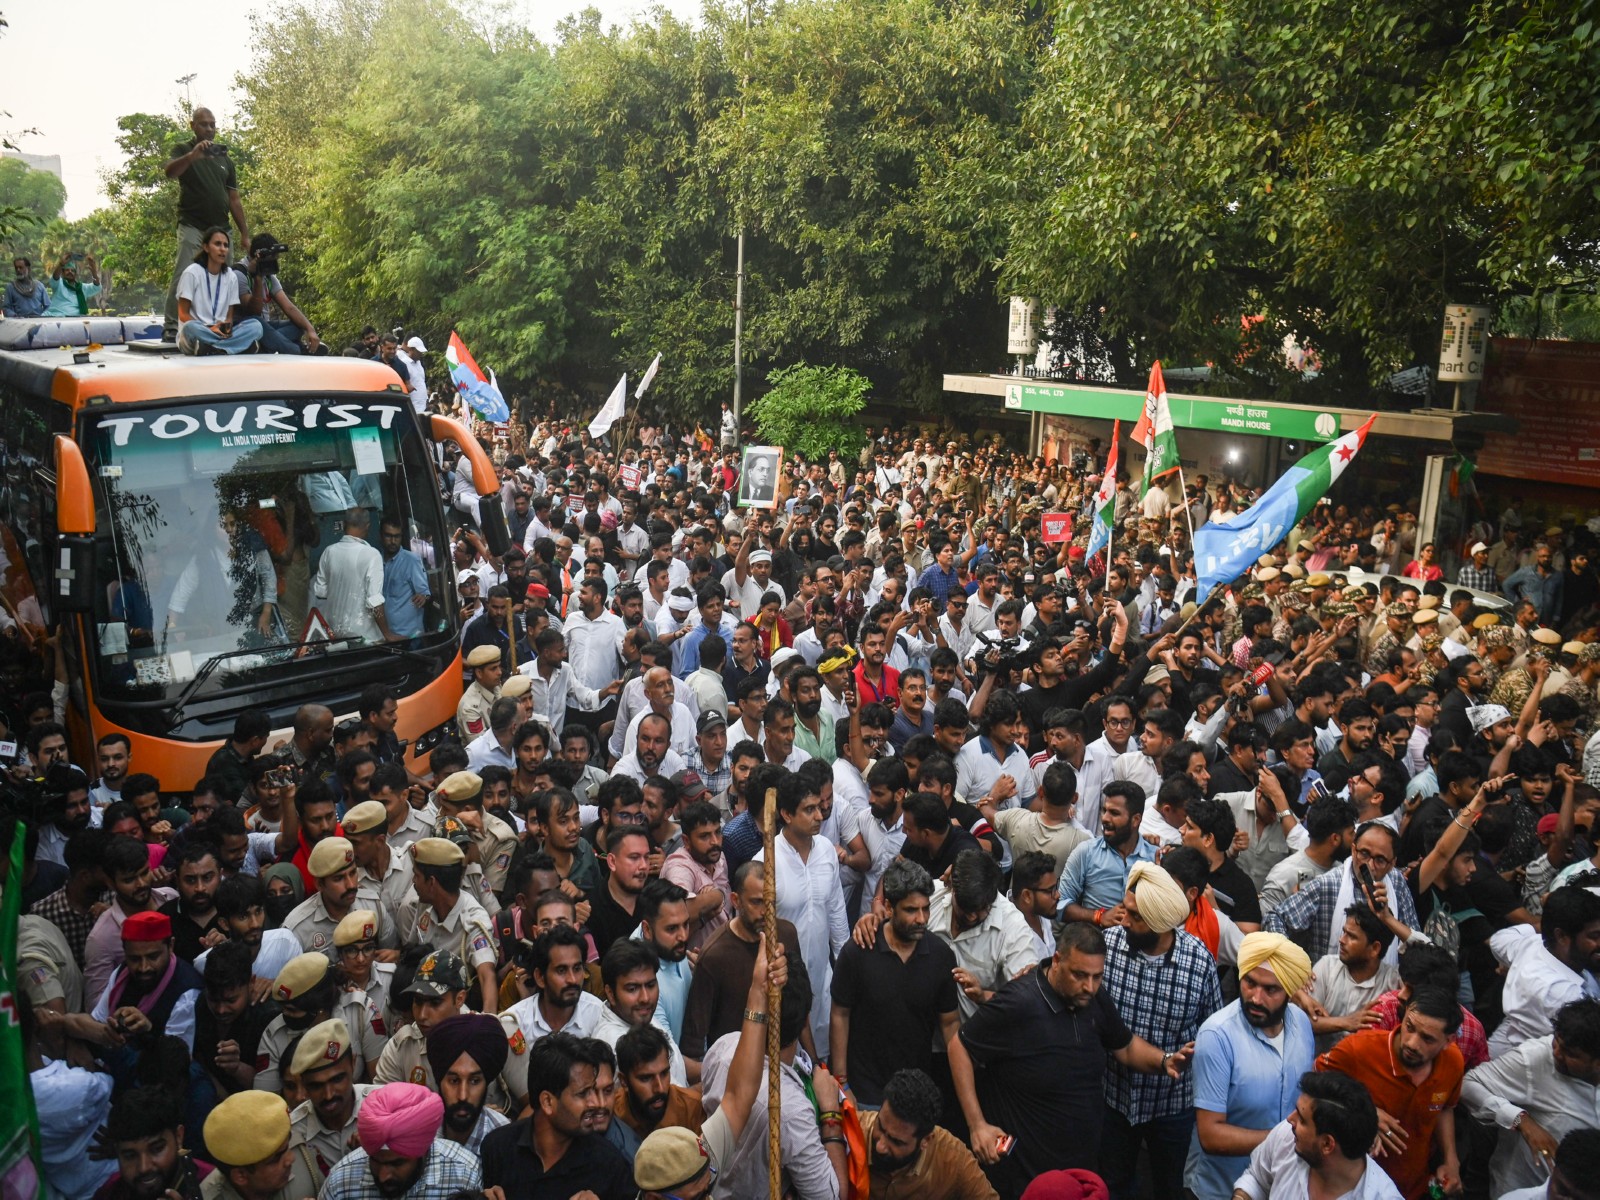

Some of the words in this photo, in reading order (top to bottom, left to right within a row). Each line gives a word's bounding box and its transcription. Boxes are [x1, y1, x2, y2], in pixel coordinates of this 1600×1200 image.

[1053, 389, 1064, 397] LTD
[1247, 408, 1268, 418] हाउस
[97, 403, 402, 446] TOURIST
[1221, 418, 1244, 428] MANDI
[1246, 421, 1271, 431] HOUSE
[222, 436, 233, 447] ALL
[234, 435, 250, 446] INDIA
[250, 434, 275, 445] TOURIST
[276, 432, 296, 444] PERMIT
